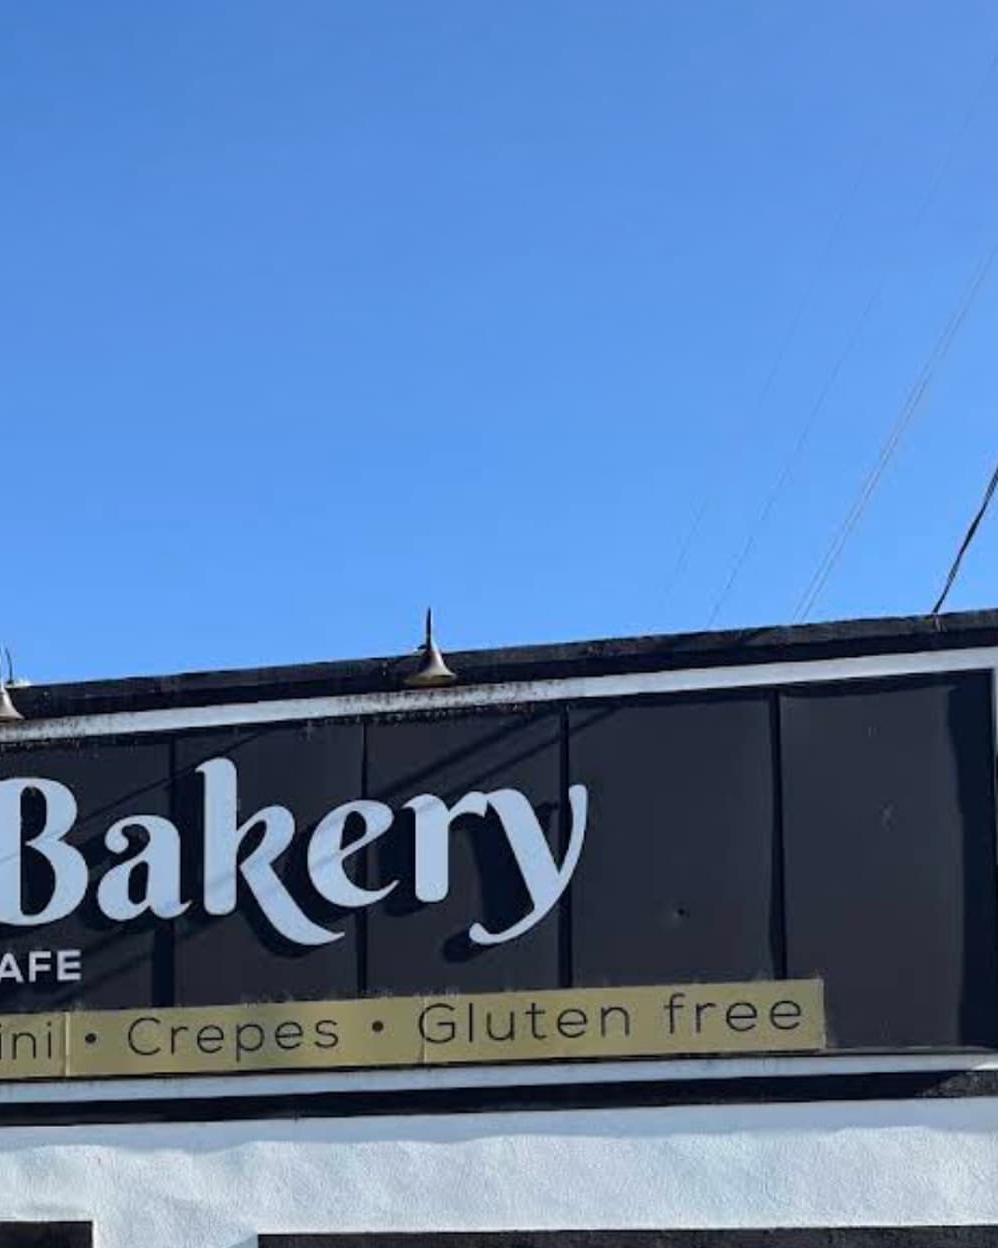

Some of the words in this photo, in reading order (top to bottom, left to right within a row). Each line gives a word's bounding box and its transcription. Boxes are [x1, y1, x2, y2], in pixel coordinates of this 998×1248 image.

[127, 1016, 340, 1062] Crepes
[417, 1001, 631, 1044] Gluten
[663, 993, 803, 1034] free
